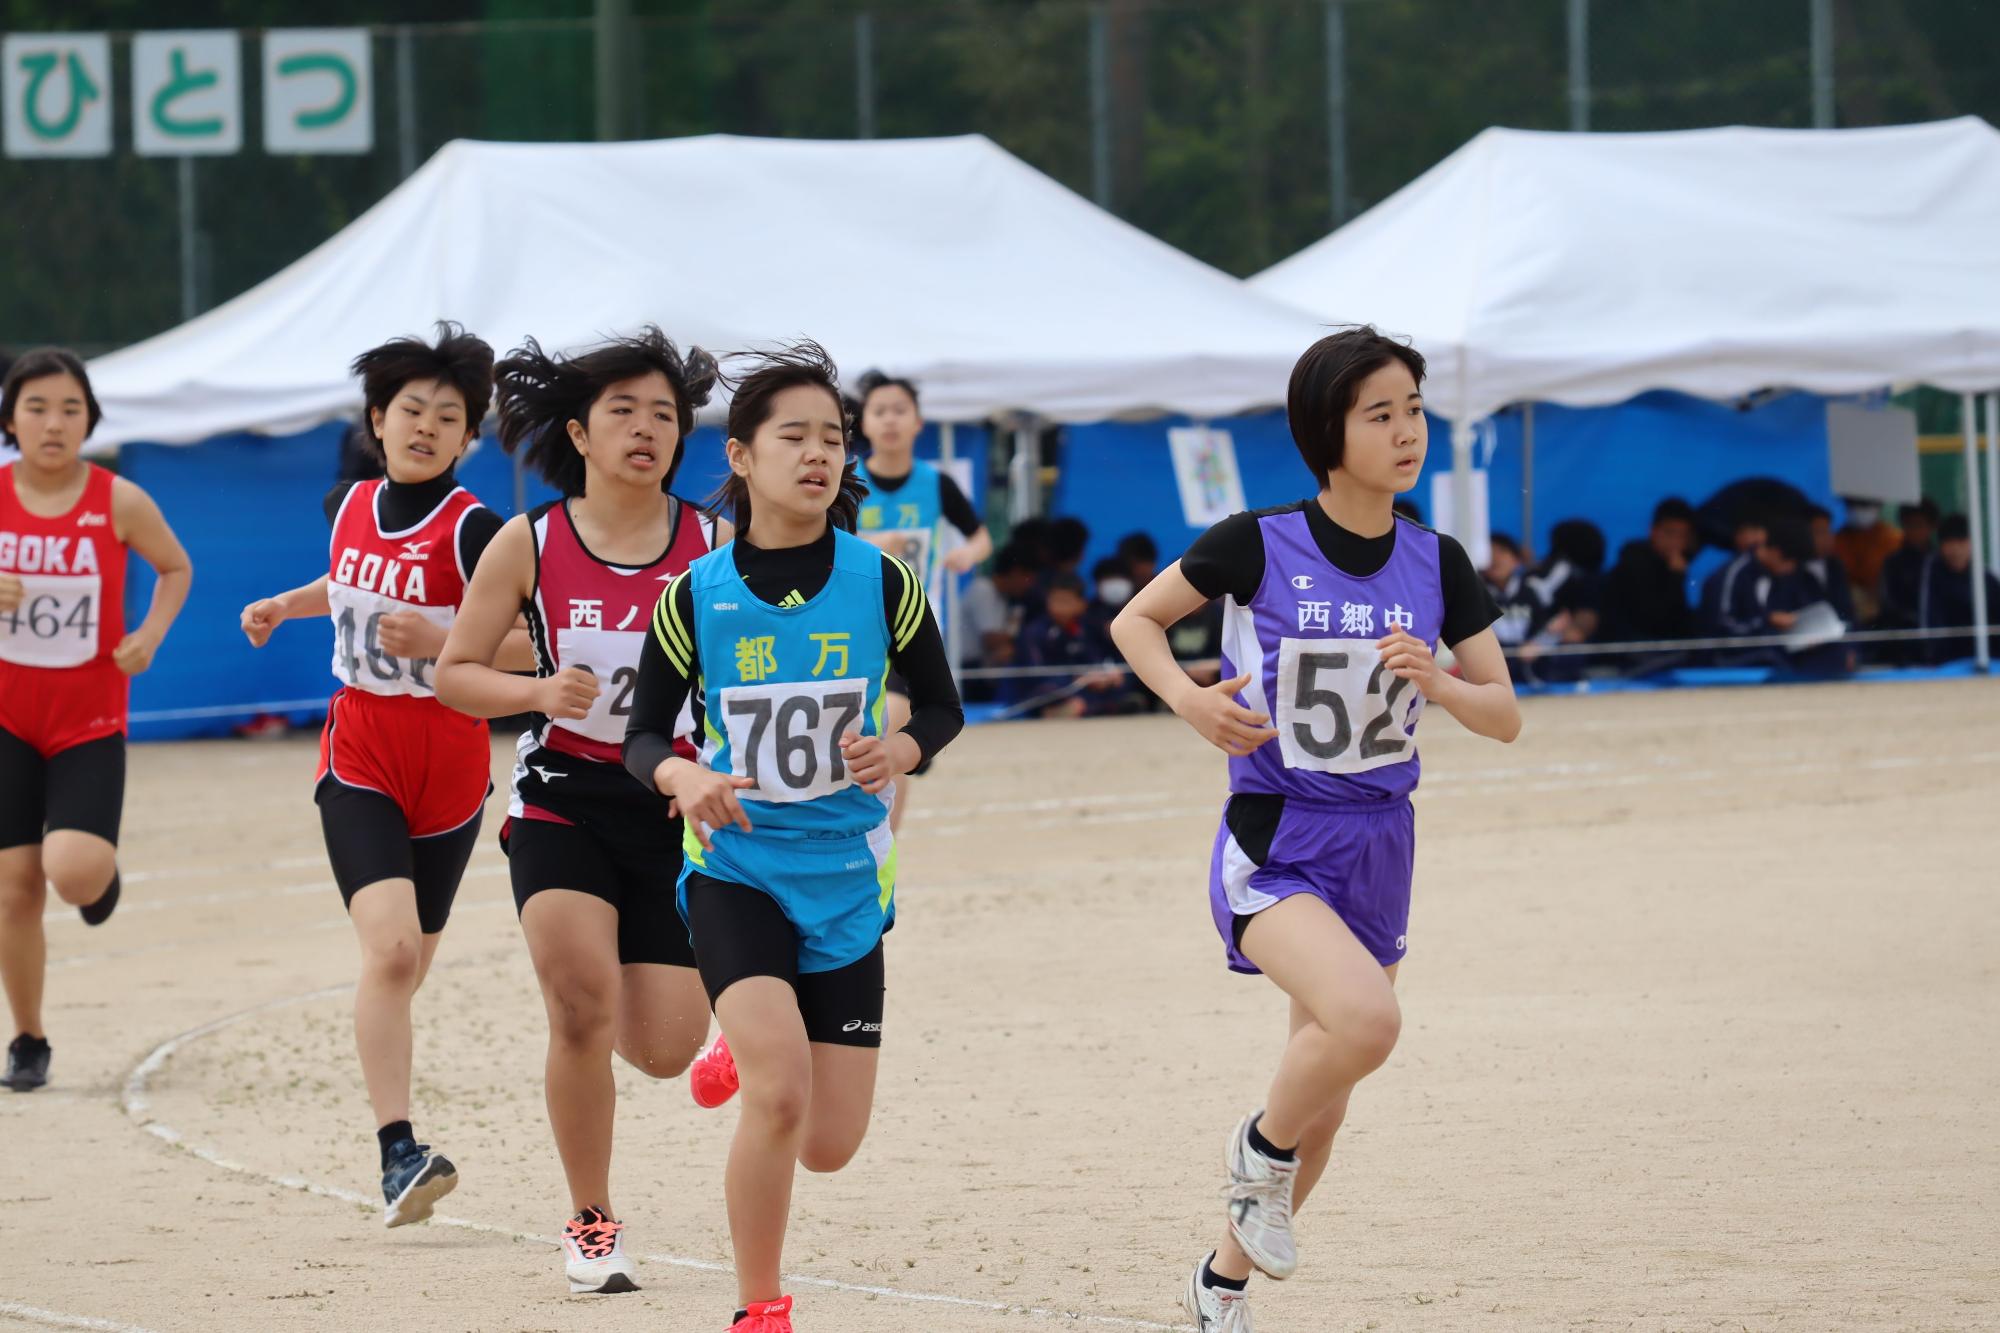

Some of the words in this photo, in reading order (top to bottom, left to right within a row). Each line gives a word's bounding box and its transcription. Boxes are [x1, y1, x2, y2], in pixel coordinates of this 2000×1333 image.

[19, 48, 358, 140] ひとつ
[335, 547, 427, 603] GOKA
[728, 691, 863, 791] 767
[1292, 652, 1411, 760] 52
